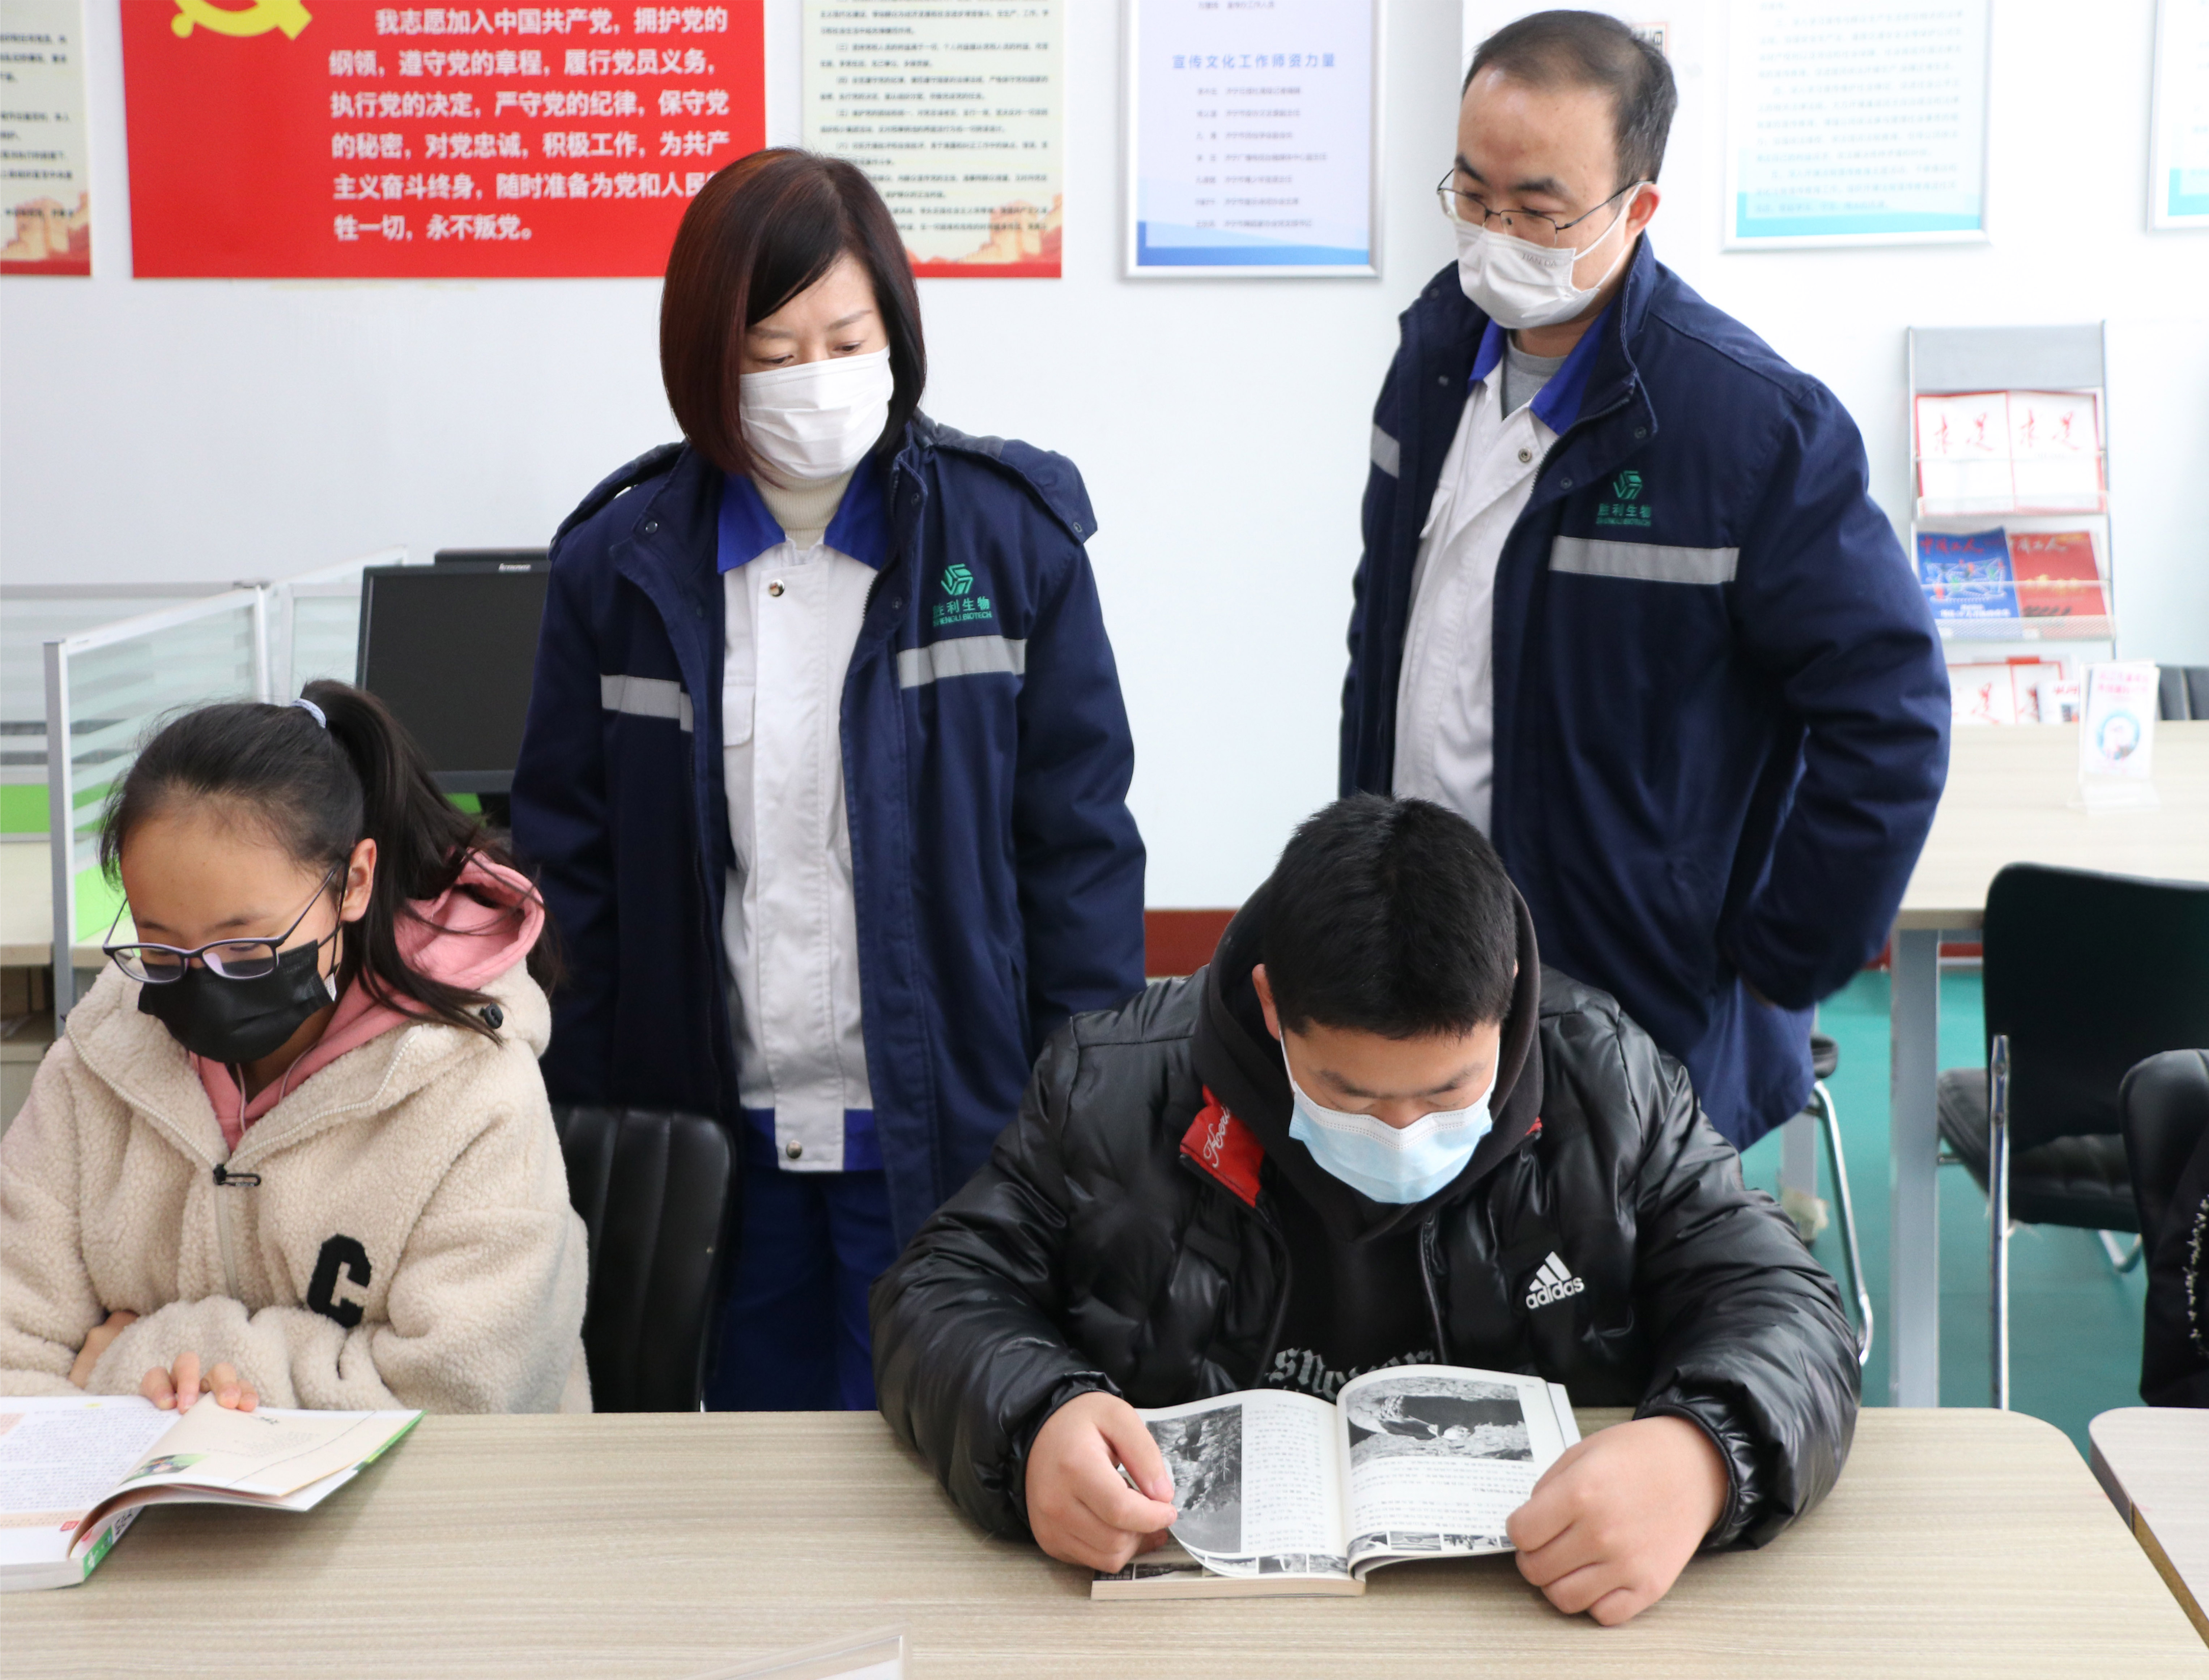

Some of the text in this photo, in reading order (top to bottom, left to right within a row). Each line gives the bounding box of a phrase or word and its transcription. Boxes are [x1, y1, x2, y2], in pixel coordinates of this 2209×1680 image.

[375, 6, 728, 35] 我志愿加入中国共产党，拥护党的
[329, 47, 715, 77] 纲领，遵守党的章程，履行党员义务，
[1172, 53, 1335, 69] 宣传文化工作师资力量
[330, 88, 729, 118] 执行党的决定，严守党的纪律，保守党
[332, 130, 730, 159] 的秘密，对党忠诚，积极工作，为共产
[333, 171, 717, 200] 主义奋斗终身，随时准备为党和人民
[334, 214, 532, 240] 牲一切，永不叛党。
[307, 1233, 371, 1329] C
[1525, 1277, 1585, 1309] adidas
